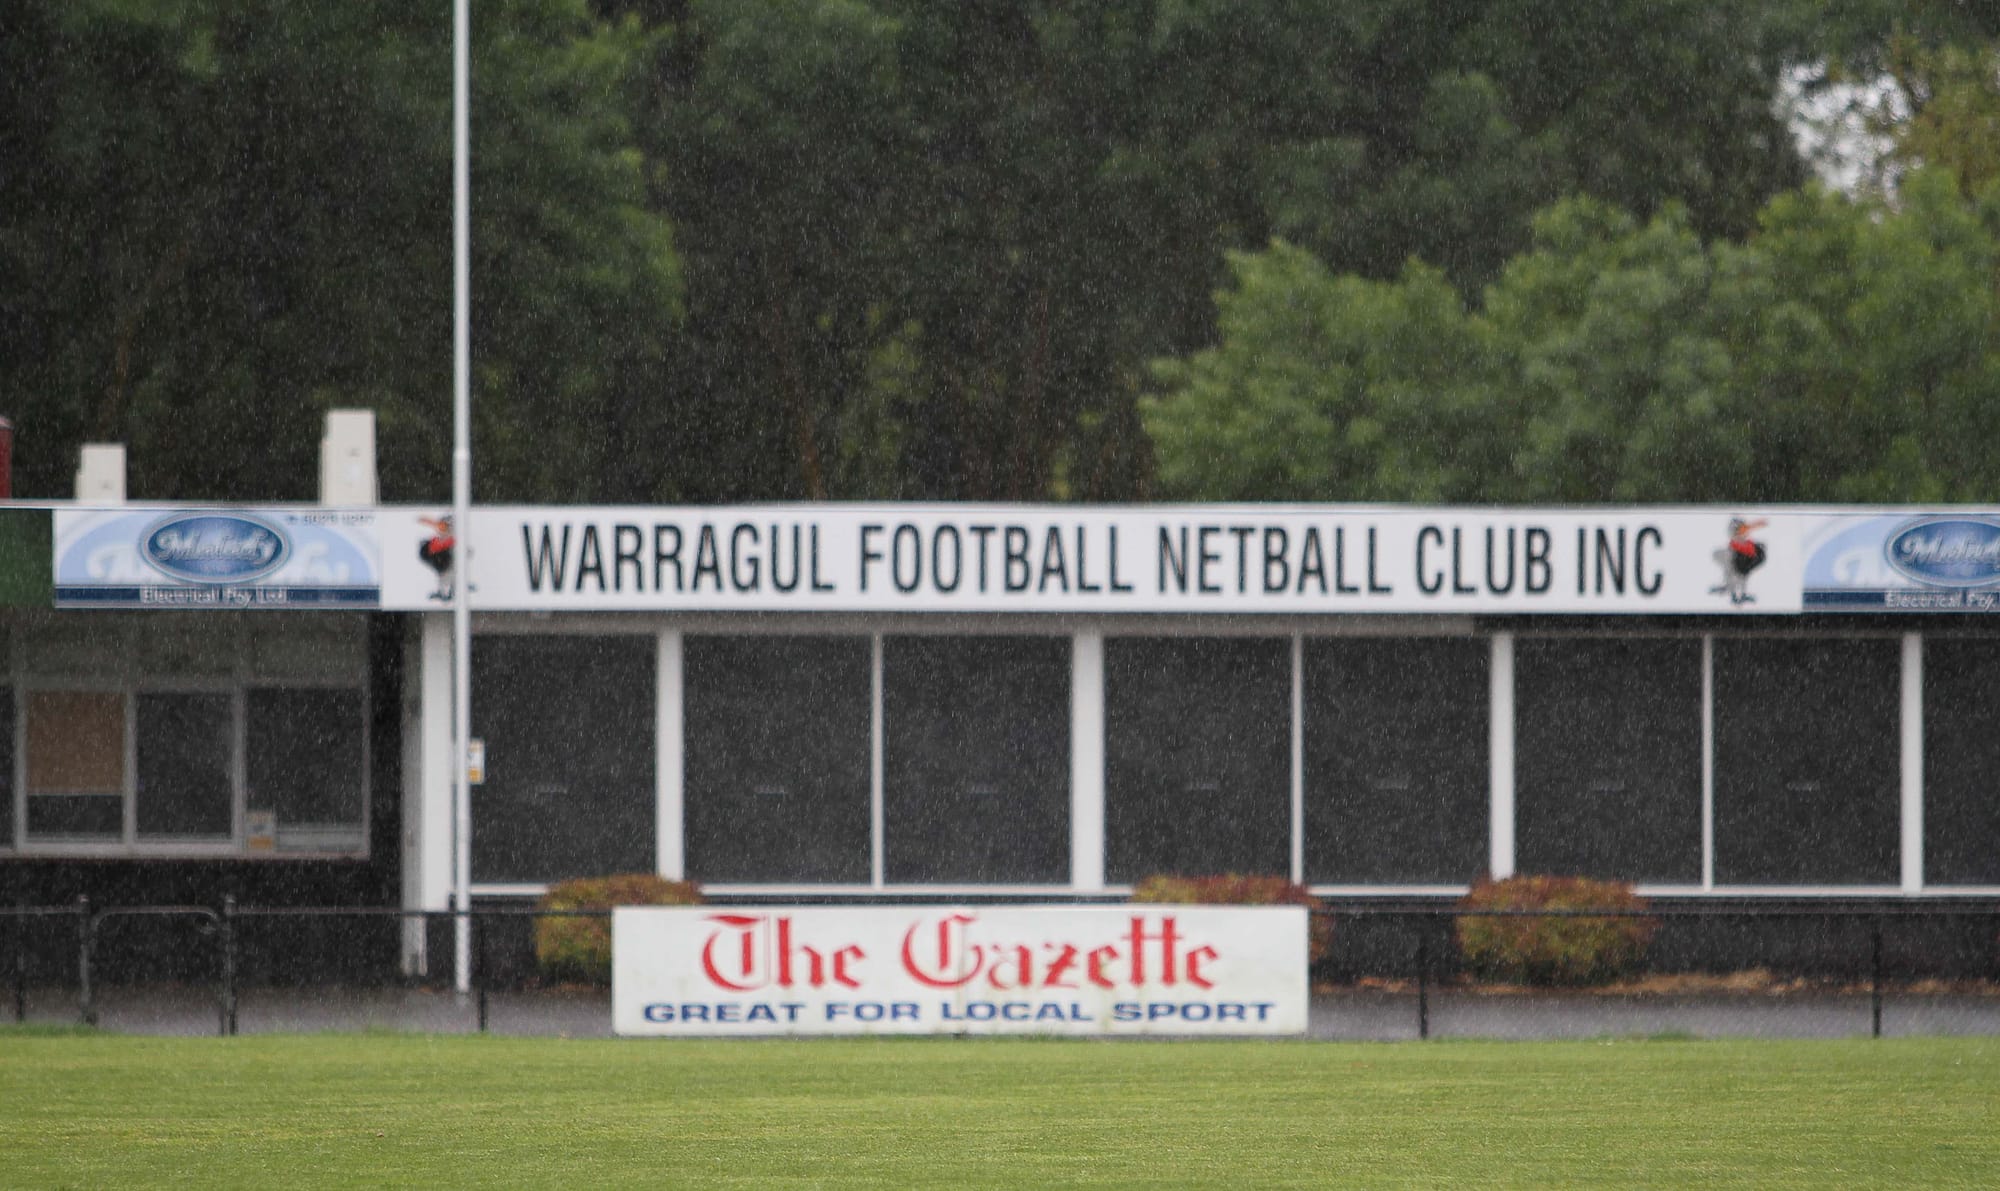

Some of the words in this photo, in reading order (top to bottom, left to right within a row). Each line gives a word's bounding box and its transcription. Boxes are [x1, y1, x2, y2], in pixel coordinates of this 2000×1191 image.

[522, 521, 834, 594] WARRAGUL
[860, 523, 1133, 594] FOOTBALL
[1158, 525, 1392, 594] NETBALL
[1415, 525, 1554, 596] CLUB
[1577, 526, 1665, 597] INC
[139, 586, 219, 603] Electrical
[1885, 590, 1962, 607] Electrical
[701, 912, 866, 992] The
[900, 912, 1220, 991] Gazette
[643, 1002, 806, 1021] GREAT
[825, 1002, 921, 1020] FOR
[941, 1002, 1093, 1020] LOCAL
[1112, 1003, 1275, 1021] SPORT
